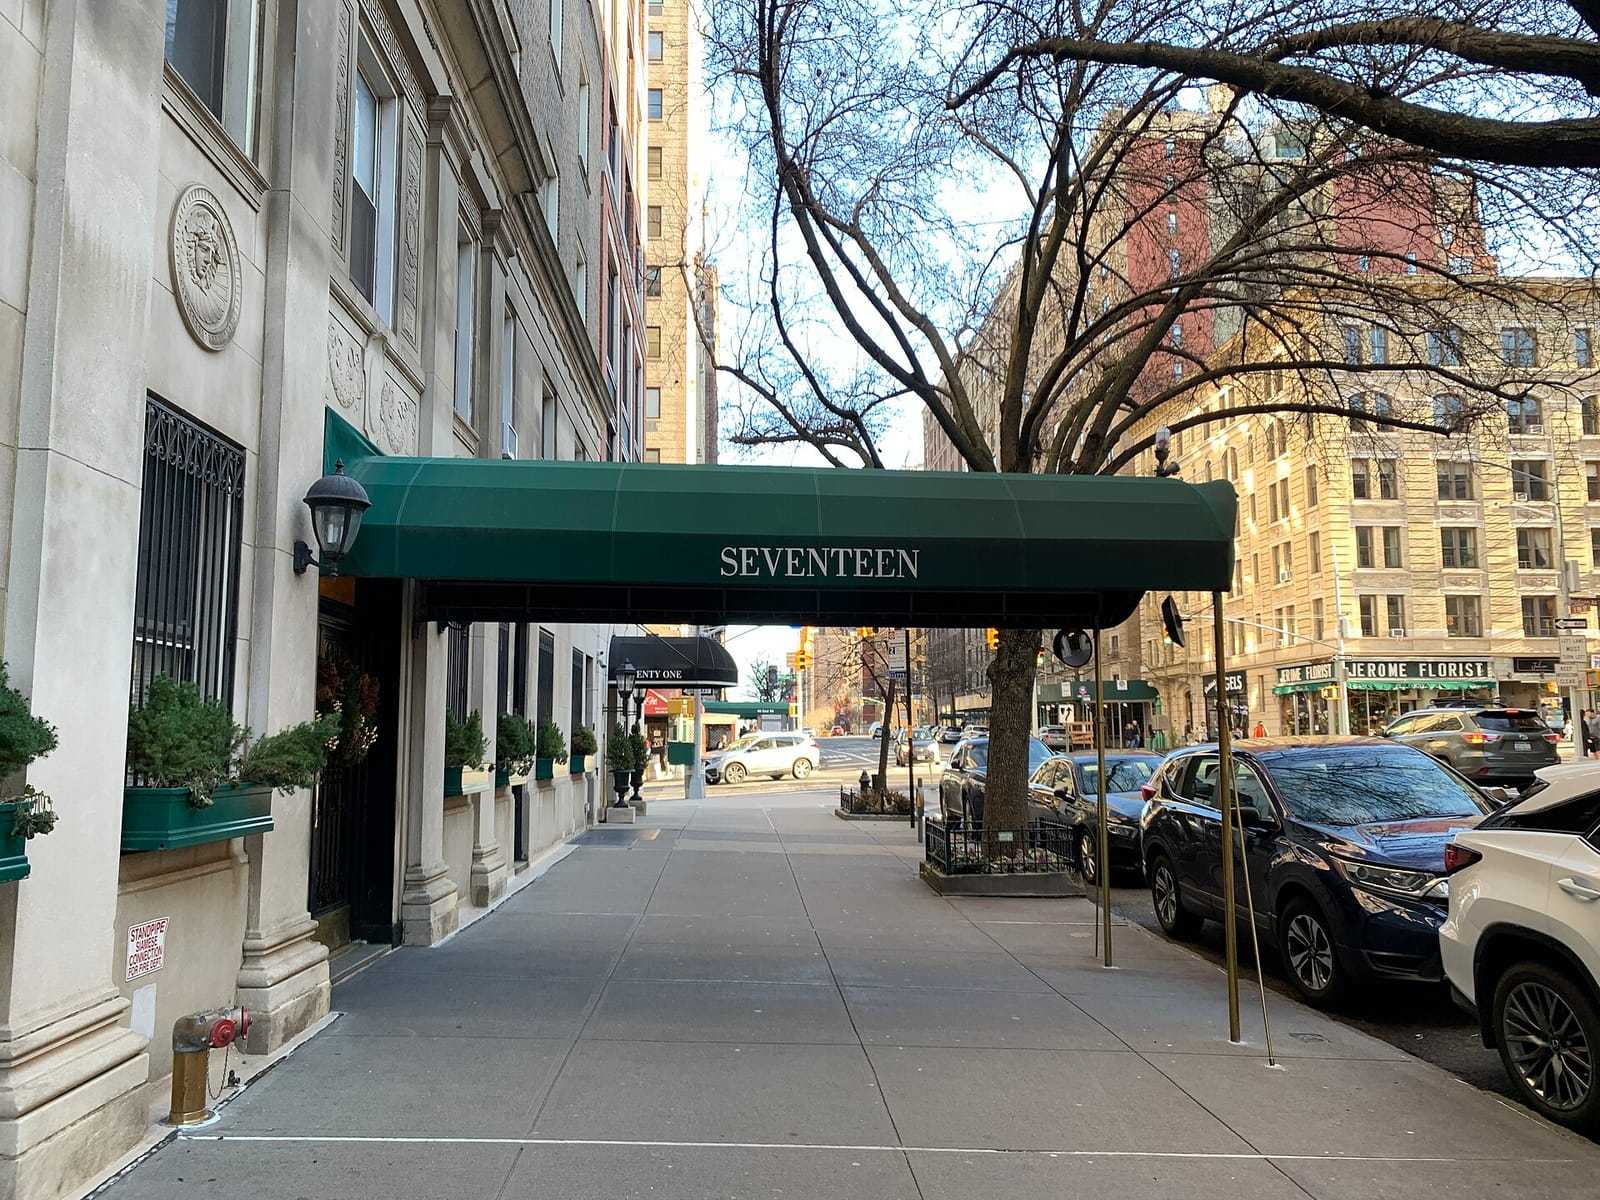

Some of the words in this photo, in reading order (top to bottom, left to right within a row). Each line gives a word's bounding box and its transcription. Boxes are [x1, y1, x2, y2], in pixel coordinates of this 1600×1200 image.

[720, 546, 920, 579] SEVENTEEN
[636, 670, 660, 679] ENTY
[662, 670, 682, 679] ONE
[1280, 667, 1302, 683] JEROME
[1305, 663, 1332, 680] FLORIST
[1348, 663, 1408, 678] JEROME
[1419, 663, 1483, 677] FLORIST
[1224, 675, 1242, 691] GELS
[131, 921, 166, 942] STANDPIPE
[136, 935, 158, 952] SIAMESE
[129, 945, 163, 967] CONNECTION
[128, 965, 138, 977] FOR
[139, 961, 149, 973] FIRE
